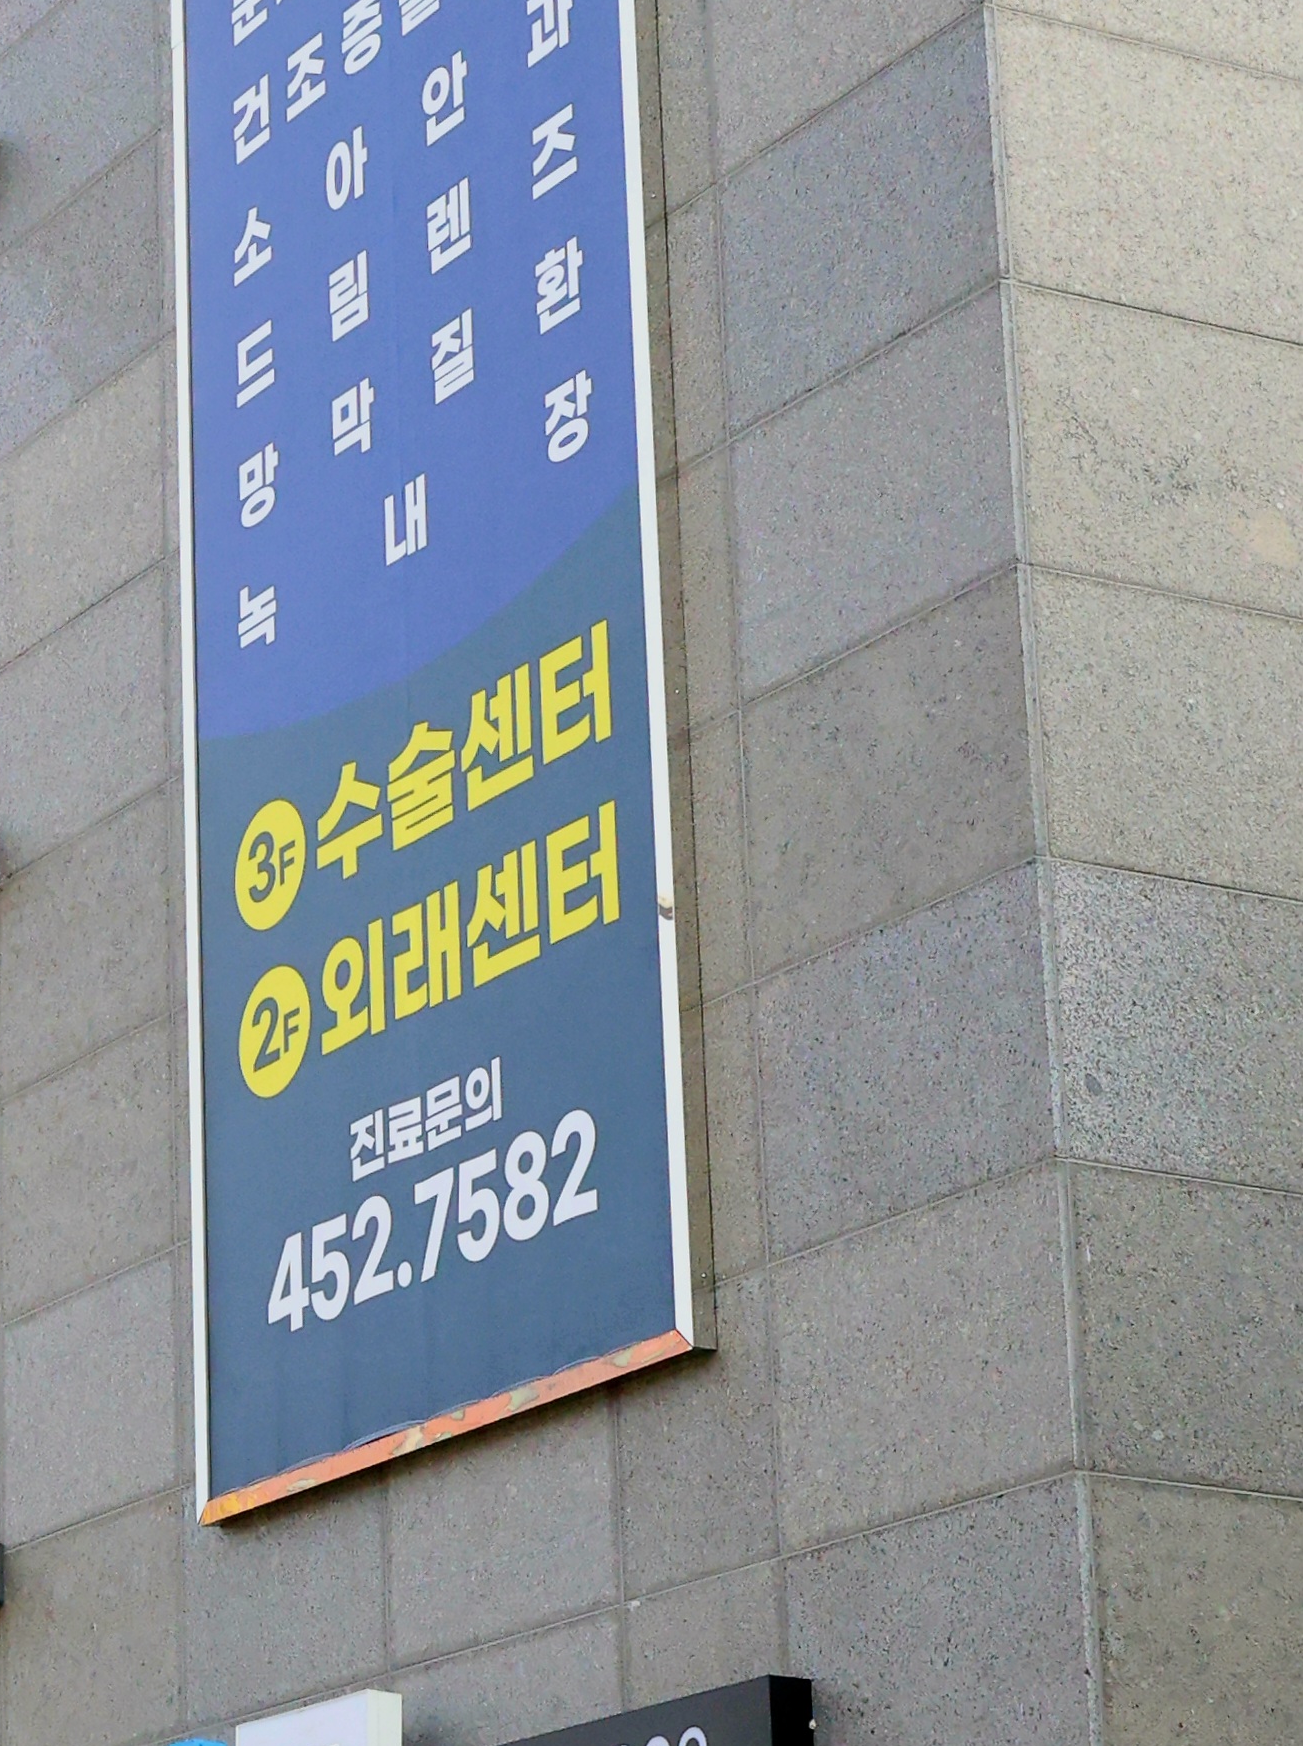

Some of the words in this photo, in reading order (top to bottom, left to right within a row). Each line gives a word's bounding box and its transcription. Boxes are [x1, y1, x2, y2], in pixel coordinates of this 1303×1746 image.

[247, 829, 297, 905] 3F
[316, 619, 613, 881] 수술센터
[250, 994, 301, 1074] 2F
[318, 801, 620, 1056] 외래센터
[266, 1108, 599, 1334] 452.7582
[349, 1056, 503, 1181] 진료문의
